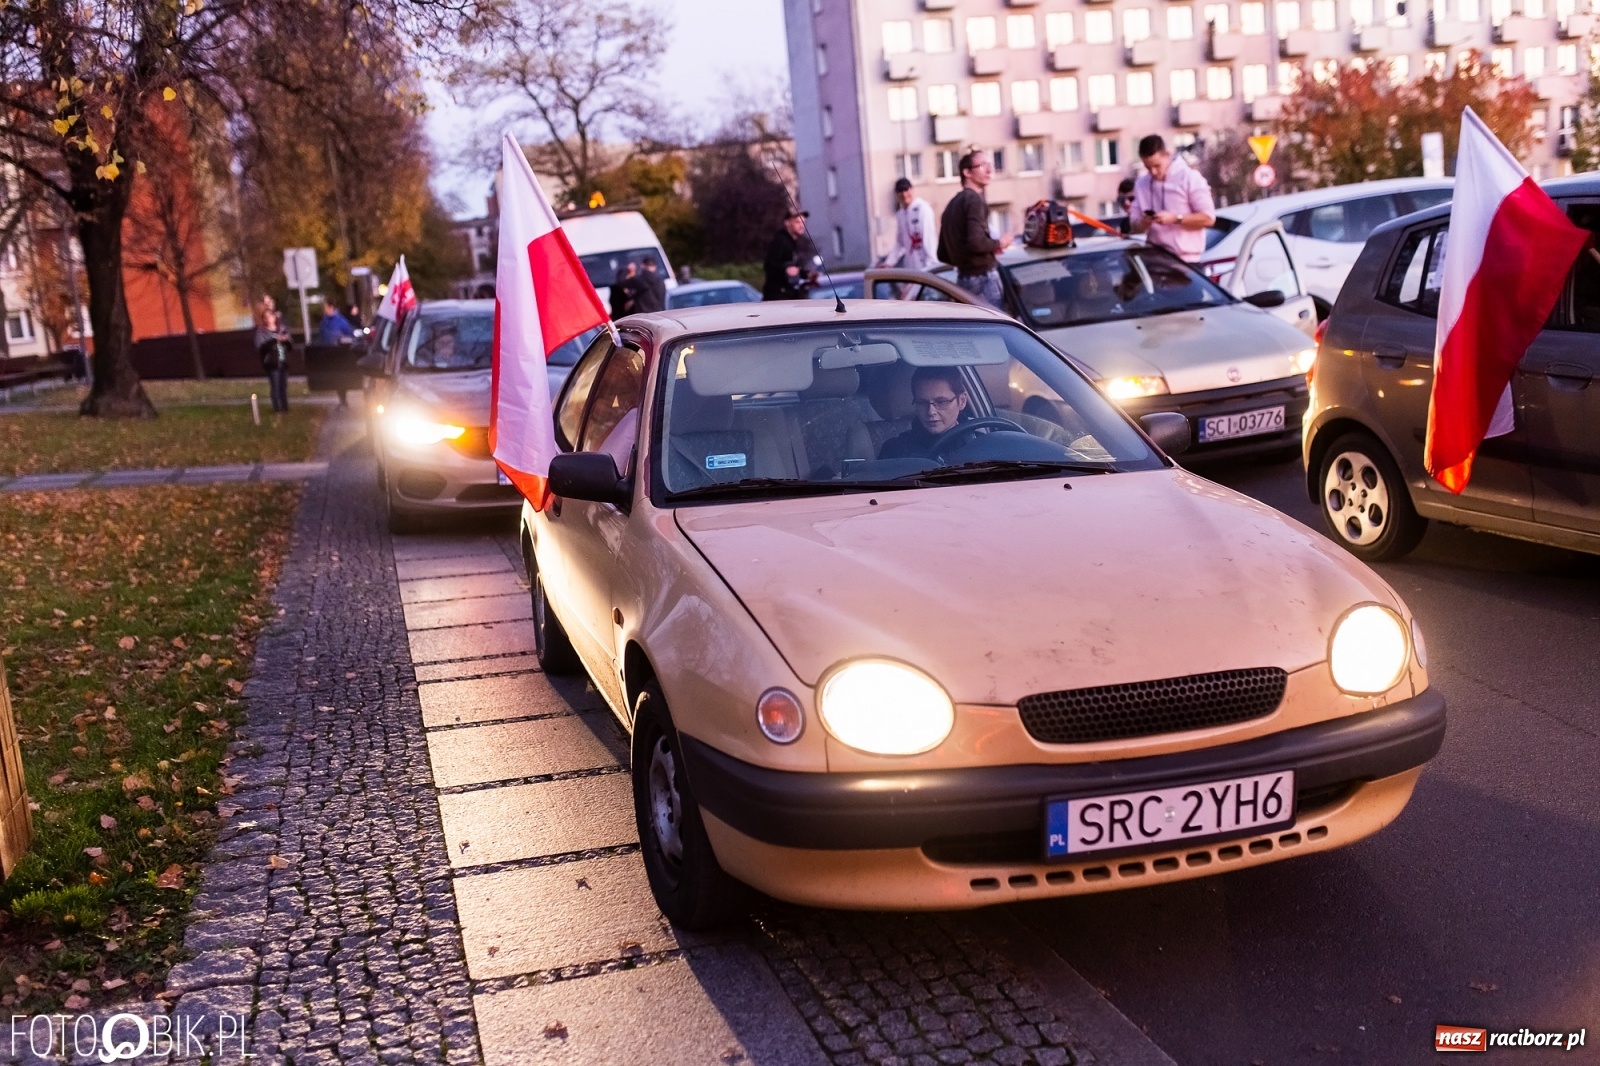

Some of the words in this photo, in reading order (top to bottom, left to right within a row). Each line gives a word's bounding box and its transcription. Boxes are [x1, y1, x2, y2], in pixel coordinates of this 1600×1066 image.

[1207, 417, 1231, 437] SCI
[1239, 410, 1283, 432] 03776
[1079, 795, 1163, 846] SRC
[1181, 776, 1284, 834] 2YH6
[1049, 834, 1065, 847] PL
